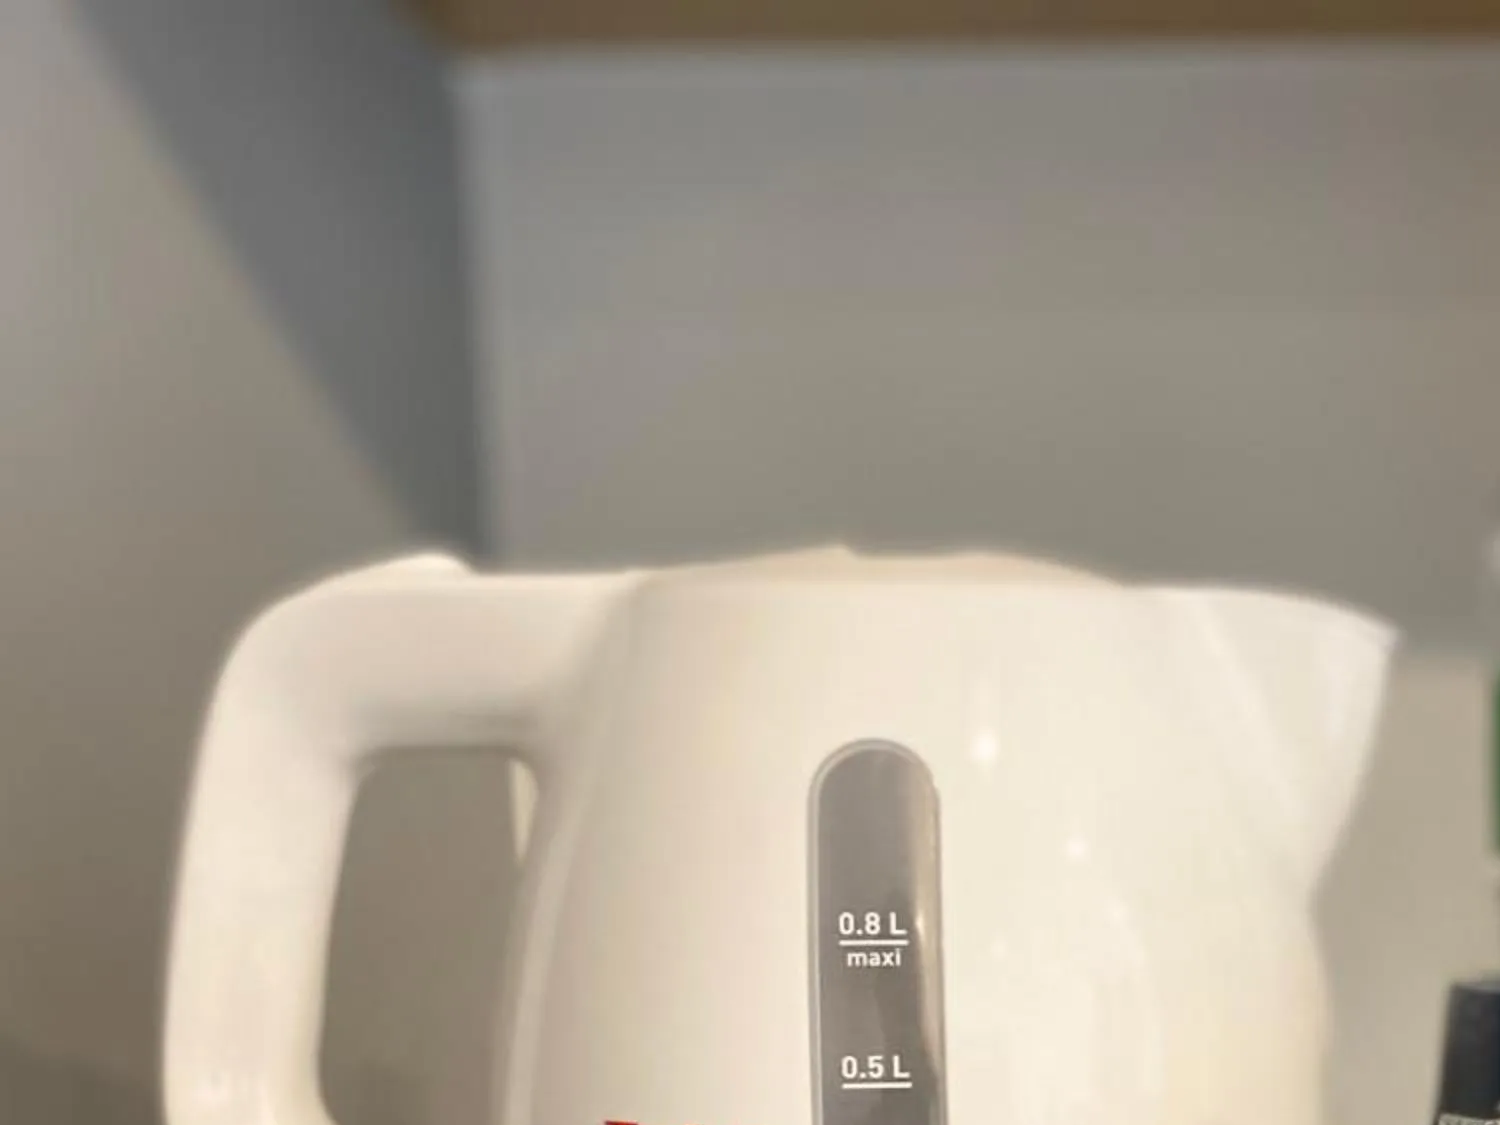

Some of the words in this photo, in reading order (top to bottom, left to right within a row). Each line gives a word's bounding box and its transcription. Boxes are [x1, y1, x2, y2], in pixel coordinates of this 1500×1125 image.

[838, 911, 882, 936] 0.8
[889, 911, 908, 936] L
[846, 948, 902, 968] maxi
[841, 1054, 885, 1079] 0.5
[892, 1054, 910, 1079] L
